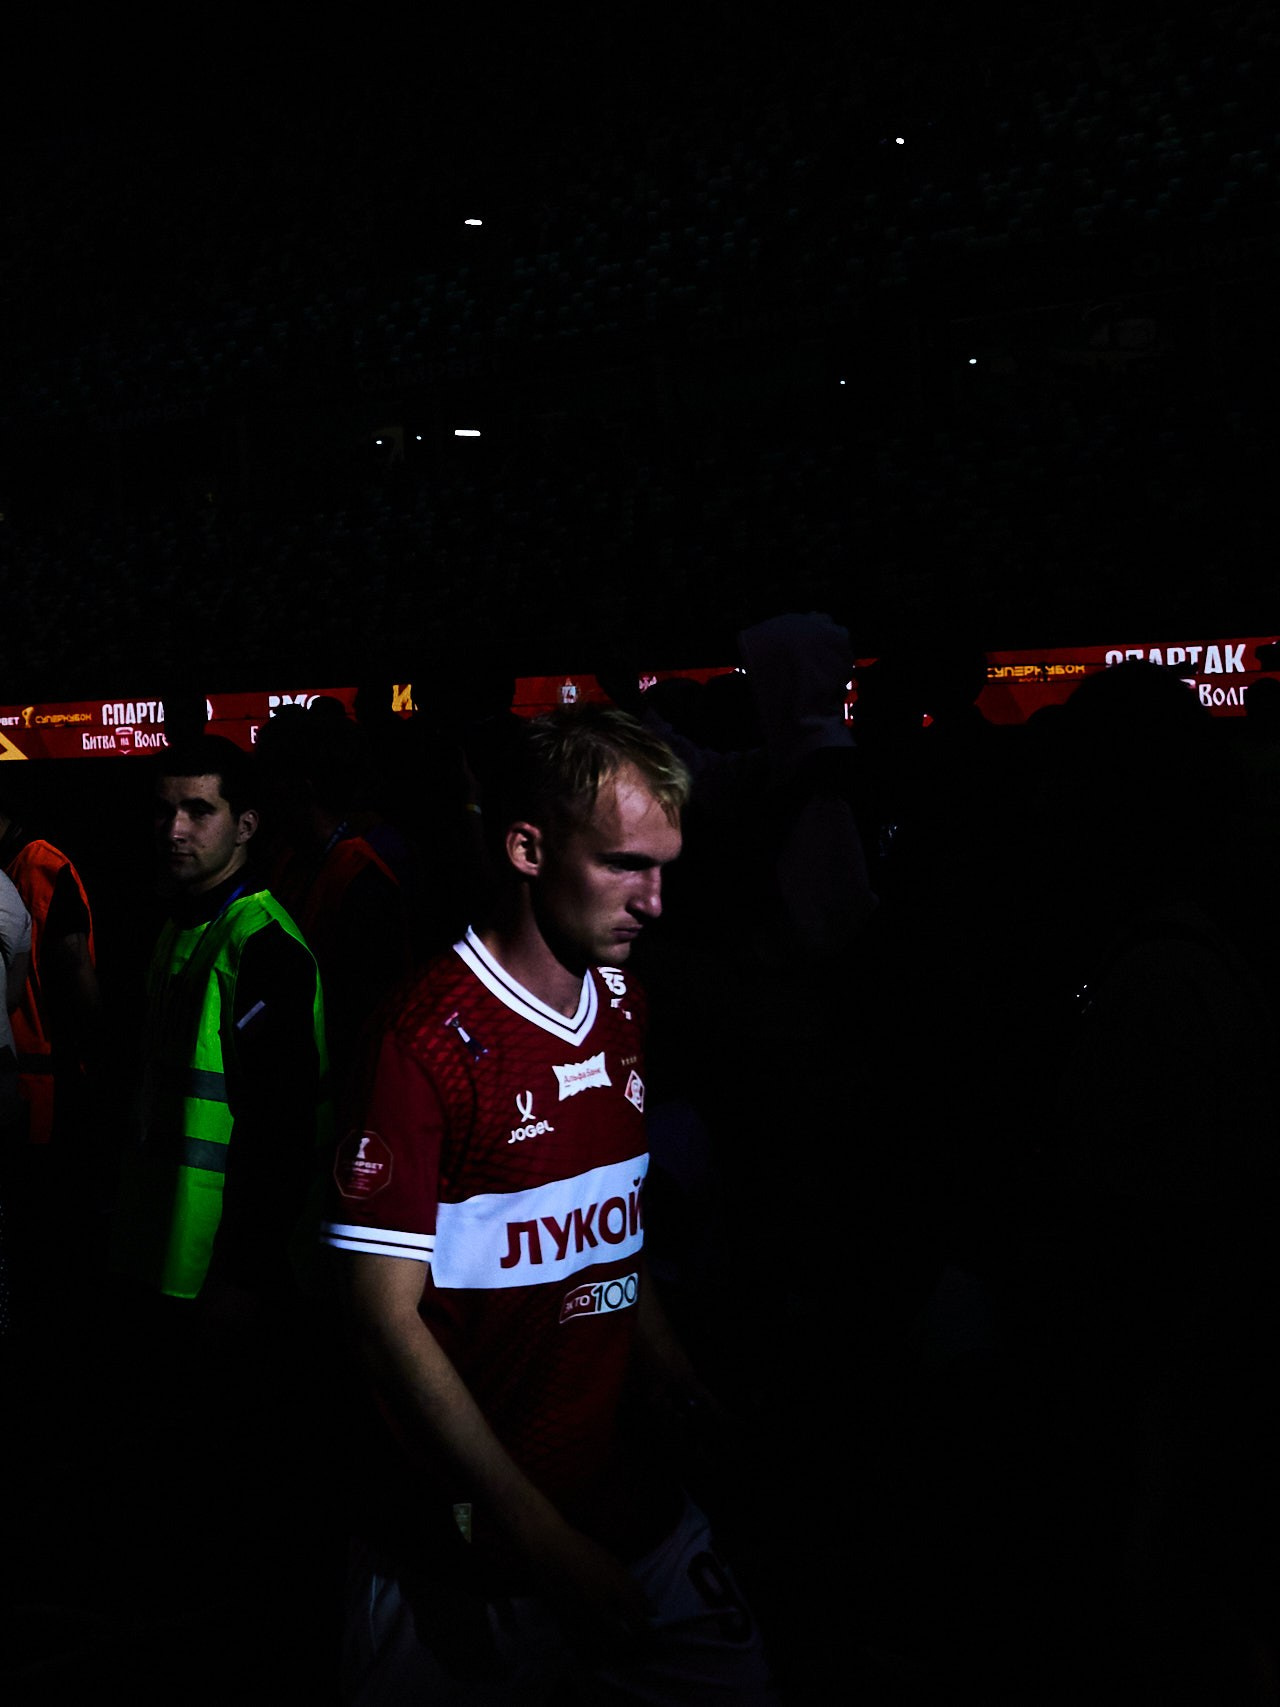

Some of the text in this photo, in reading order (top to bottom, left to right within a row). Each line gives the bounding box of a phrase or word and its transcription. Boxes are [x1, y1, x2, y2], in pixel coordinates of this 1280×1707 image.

[1199, 683, 1248, 706] Волг
[102, 701, 164, 725] СПАРТА
[506, 1119, 555, 1144] JOGEL
[500, 1177, 644, 1269] ЛУКОЙ
[593, 1275, 637, 1312] 100
